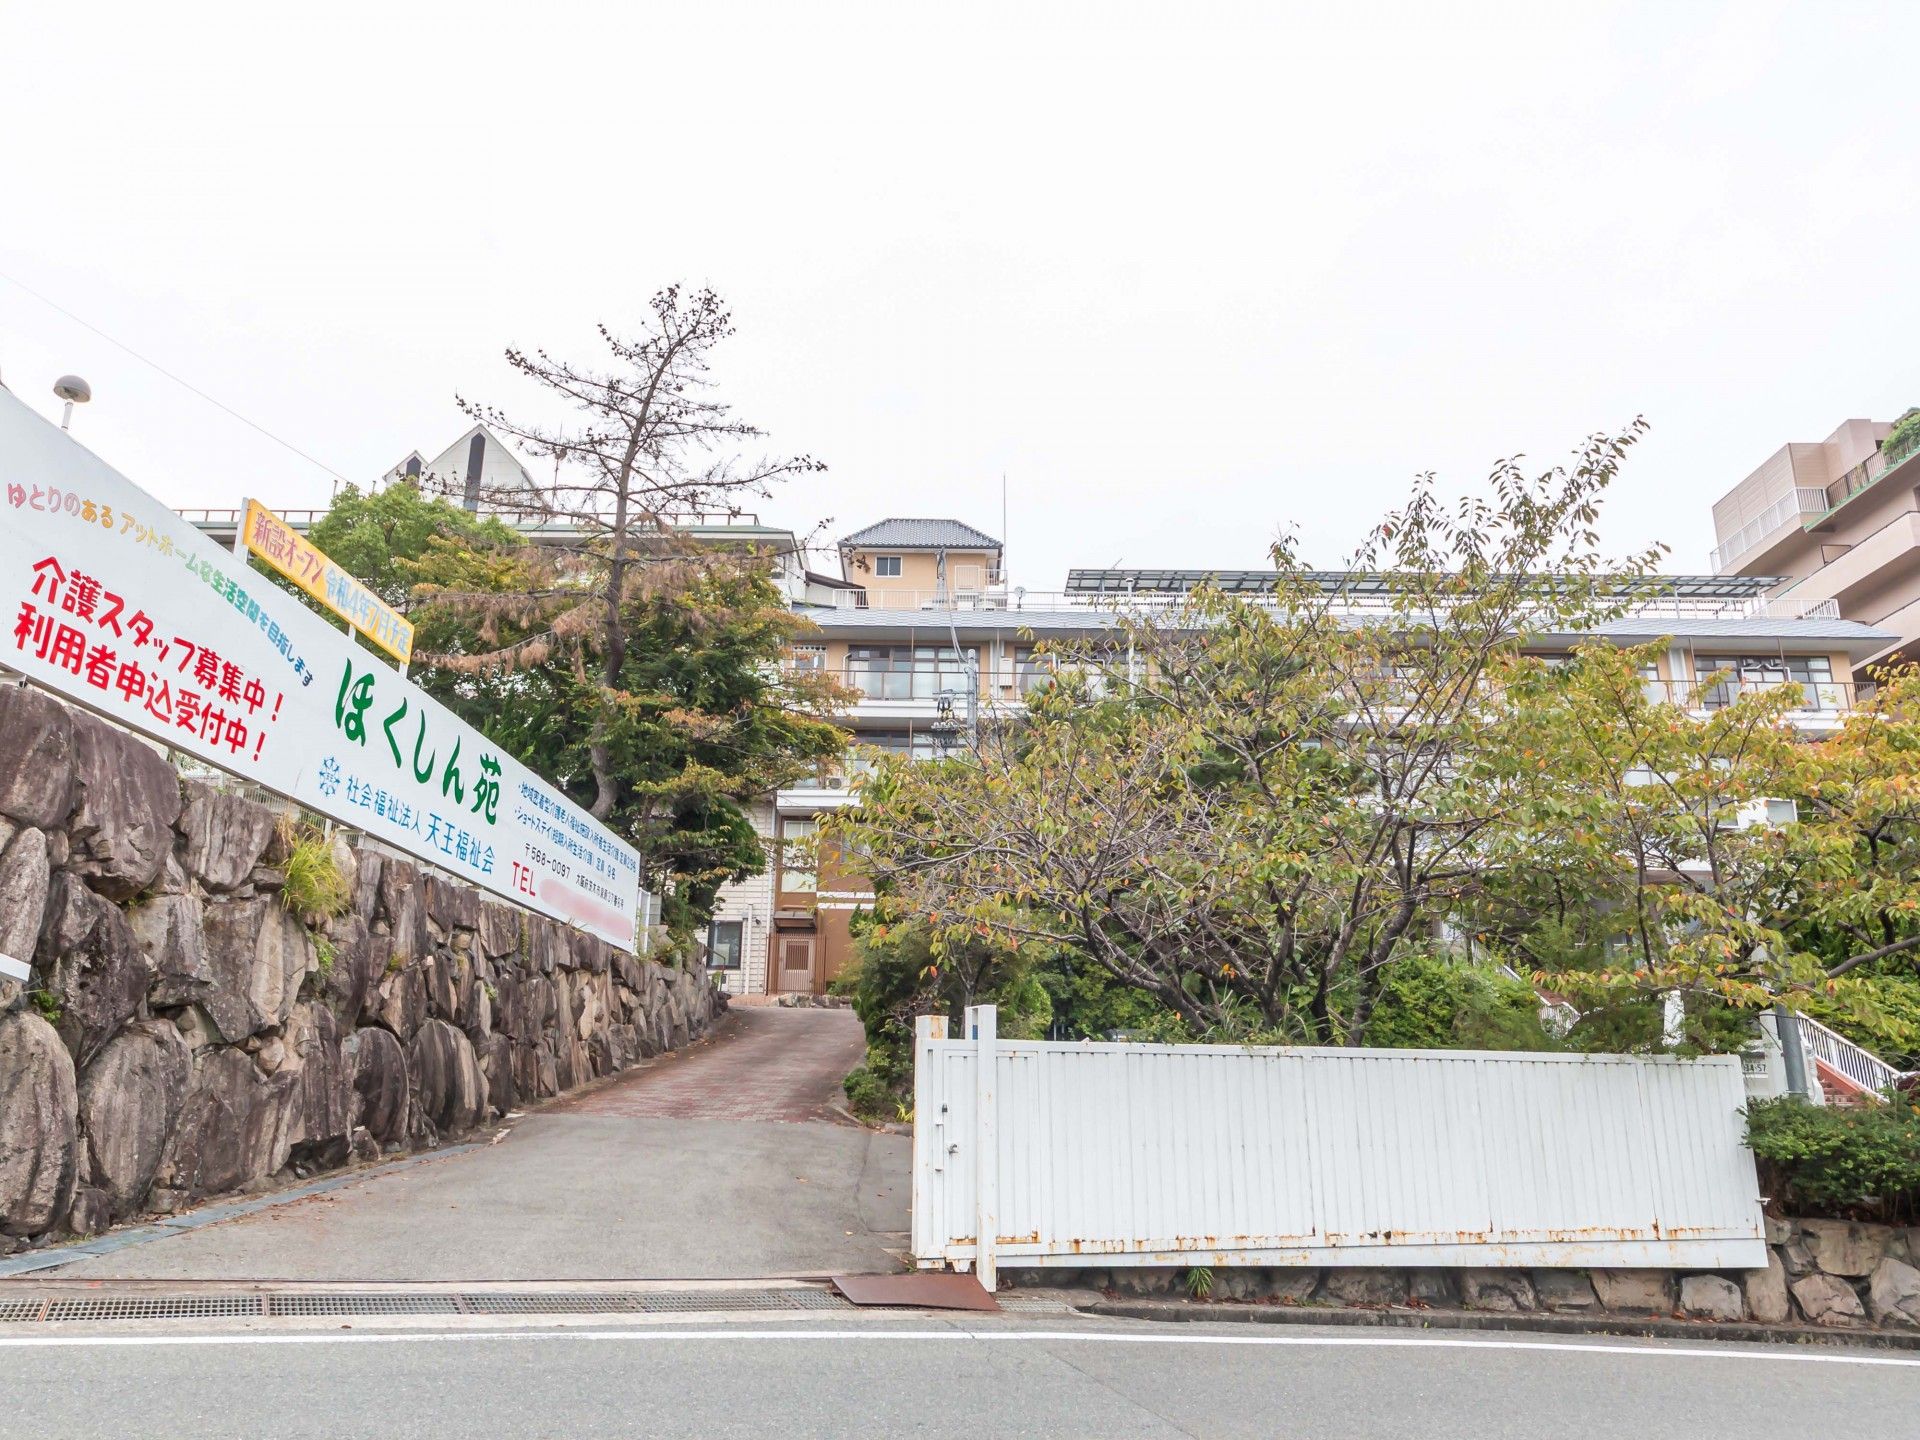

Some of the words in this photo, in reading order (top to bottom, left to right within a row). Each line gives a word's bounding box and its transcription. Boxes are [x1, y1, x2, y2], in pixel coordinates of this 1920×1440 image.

[8, 483, 114, 529] ゆとりのある
[120, 512, 314, 687] アットホームな生活空間を目指します
[254, 511, 326, 585] 新設オープン
[14, 601, 266, 762] 利用者申込受付中！
[31, 556, 284, 722] 介護スタッフ募集中！
[335, 657, 502, 826] ほくしん苑
[346, 774, 421, 836] 社会福祉法人
[425, 812, 496, 876] 天王福祉会
[512, 860, 537, 897] TEL
